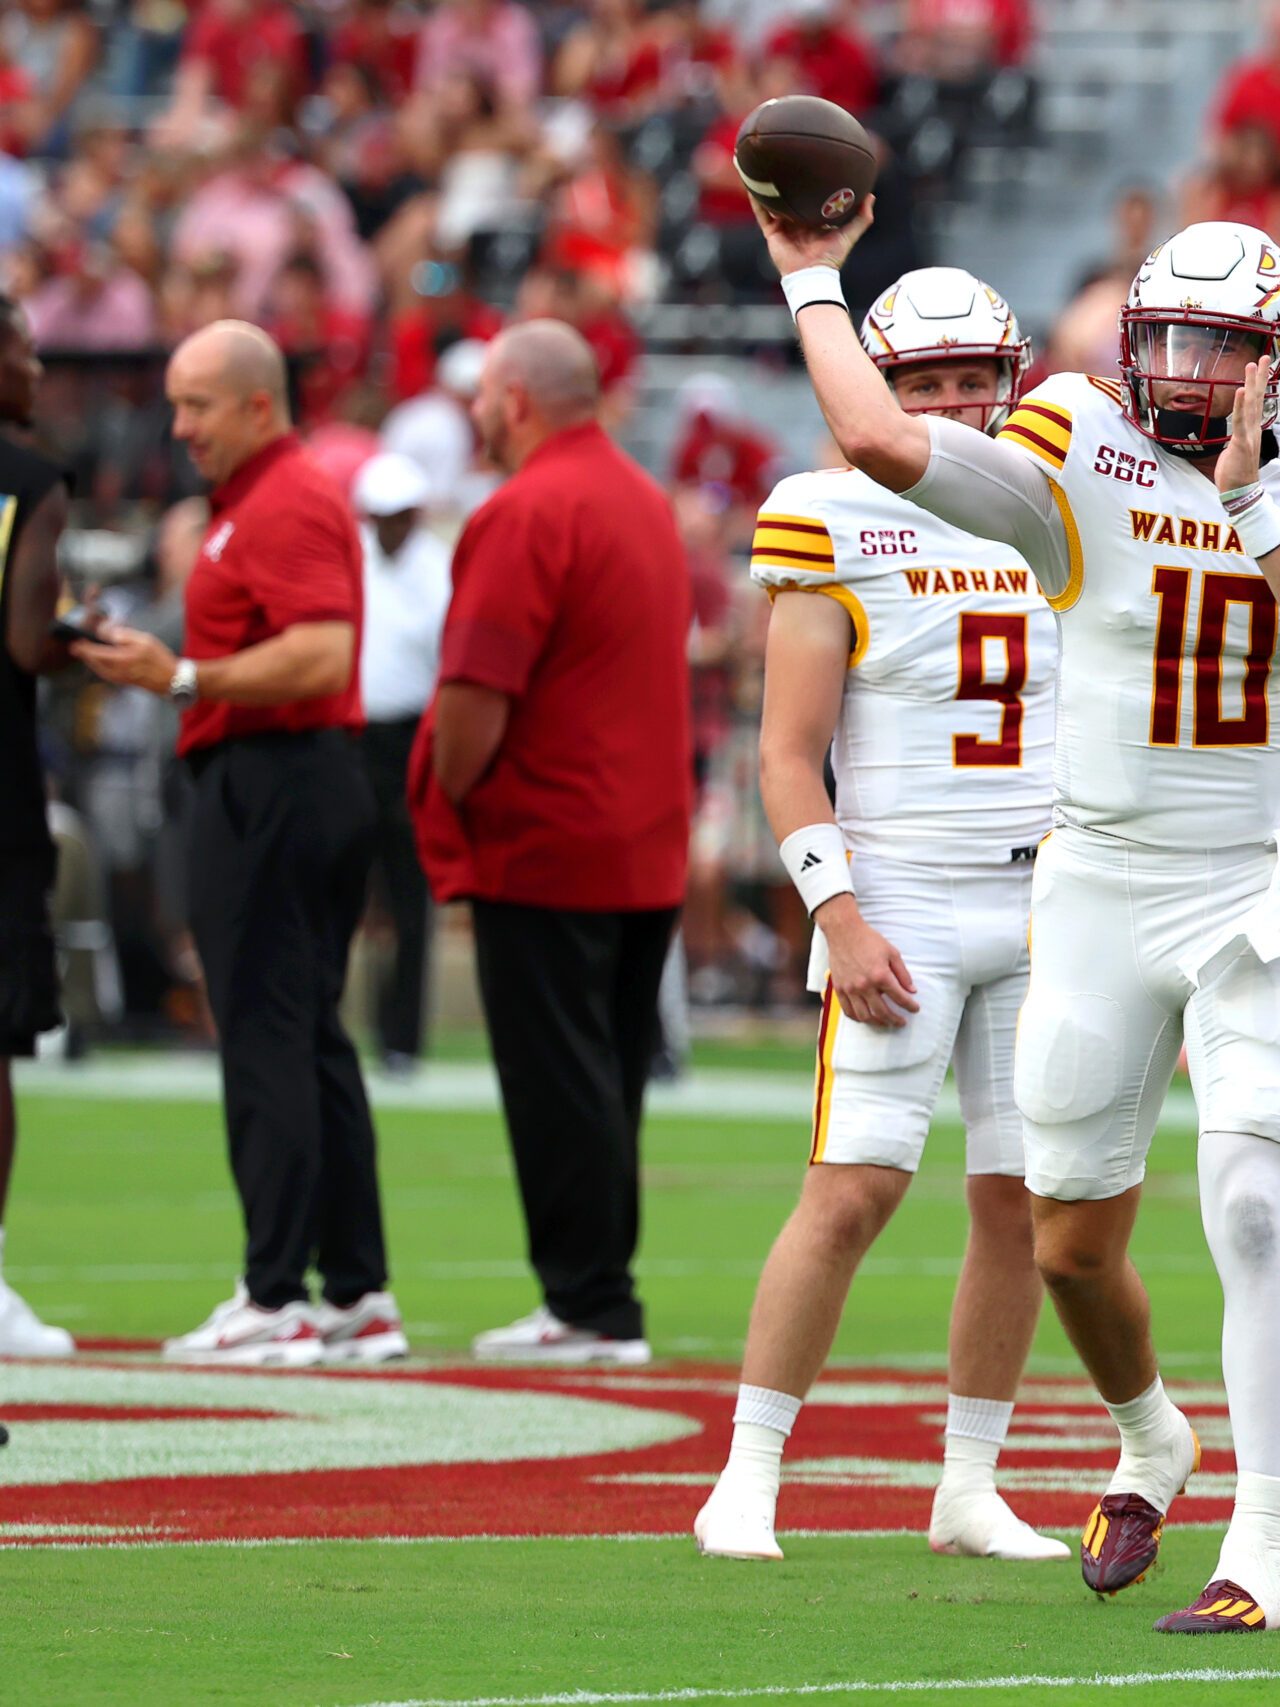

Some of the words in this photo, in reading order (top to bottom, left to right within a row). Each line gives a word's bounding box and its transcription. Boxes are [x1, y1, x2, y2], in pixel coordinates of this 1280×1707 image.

[1093, 444, 1158, 488] SBC
[860, 529, 918, 556] SBC
[1128, 508, 1247, 555] WARHA
[1149, 564, 1279, 748] 10
[952, 611, 1029, 768] 9
